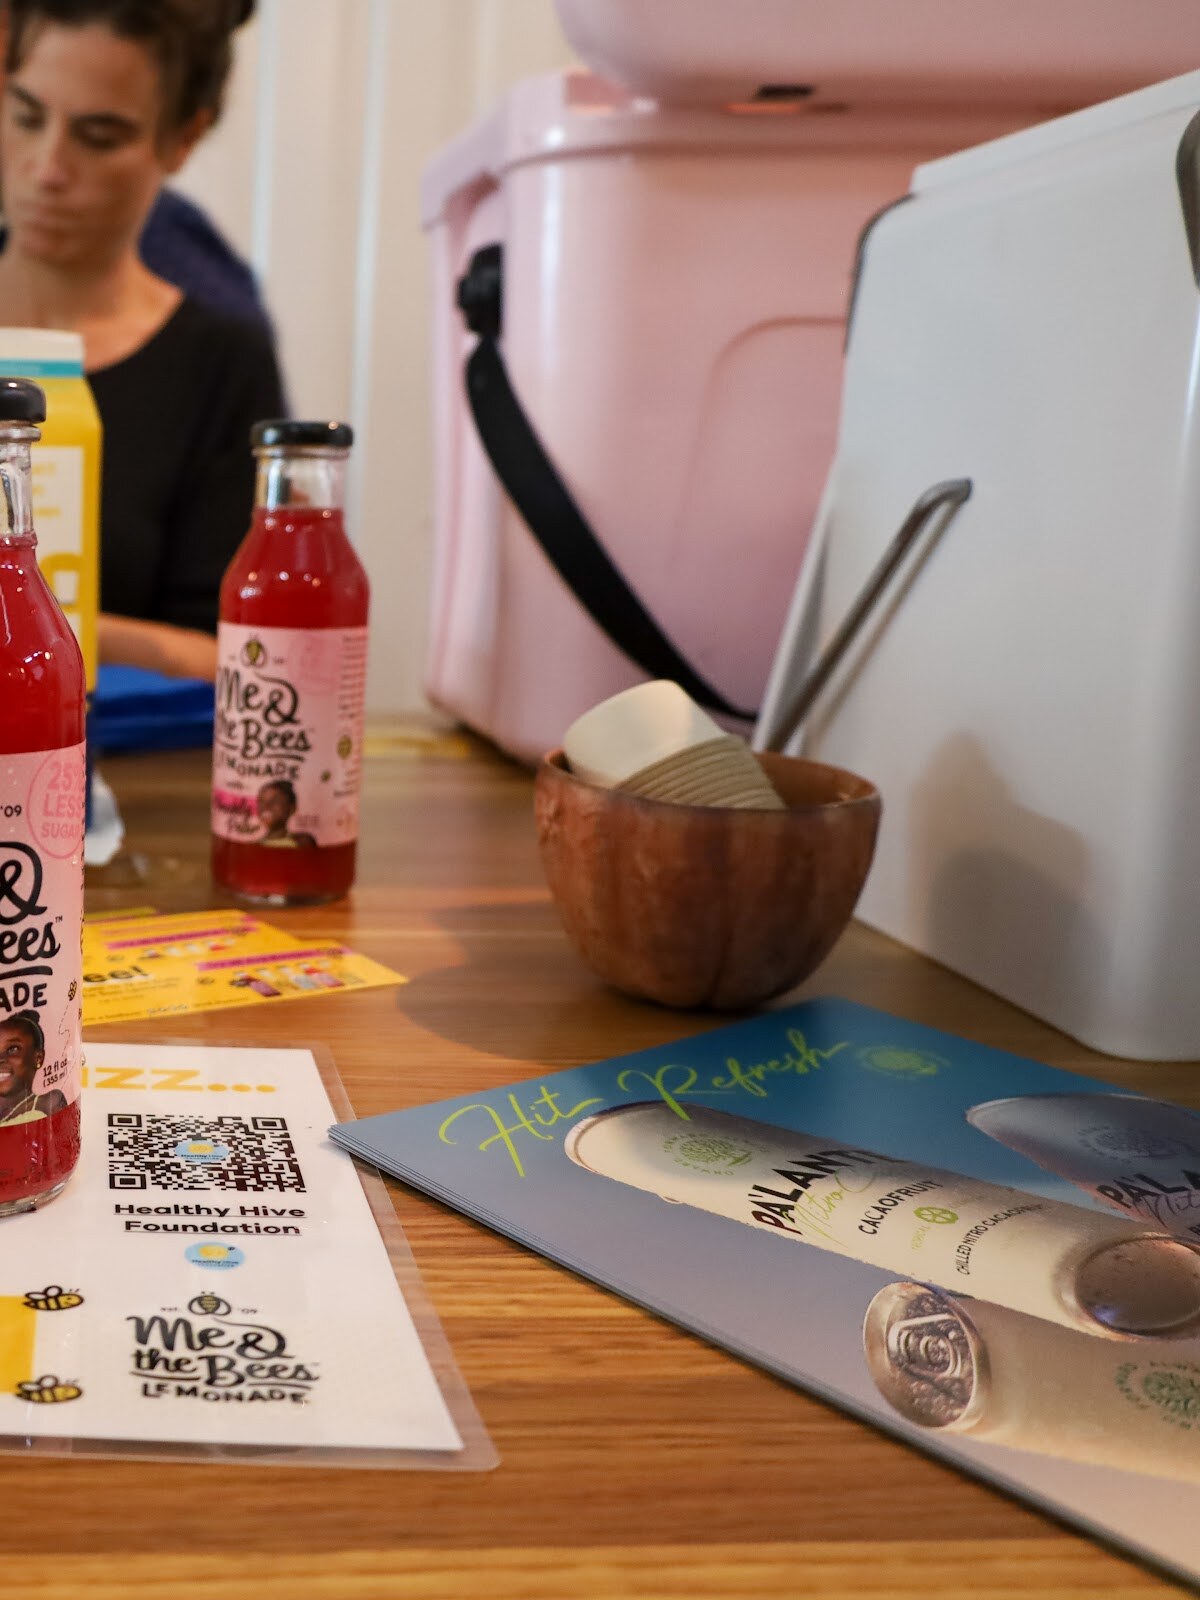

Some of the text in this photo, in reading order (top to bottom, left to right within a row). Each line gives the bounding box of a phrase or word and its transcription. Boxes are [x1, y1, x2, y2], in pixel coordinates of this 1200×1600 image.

[241, 718, 311, 760] Bees
[0, 805, 22, 818] '09
[43, 1065, 52, 1077] 12
[438, 1085, 603, 1177] Hit
[617, 1028, 850, 1121] Refresh
[115, 1204, 305, 1218] Healthy Hive
[858, 1179, 944, 1236] CACAOFRUIT
[125, 1221, 300, 1234] Foundation
[961, 1224, 989, 1246] NITRO
[956, 1244, 971, 1275] CHILLED
[126, 1316, 295, 1360] Me &
[130, 1349, 320, 1388] the Bees
[141, 1383, 307, 1405] LEMONADE
